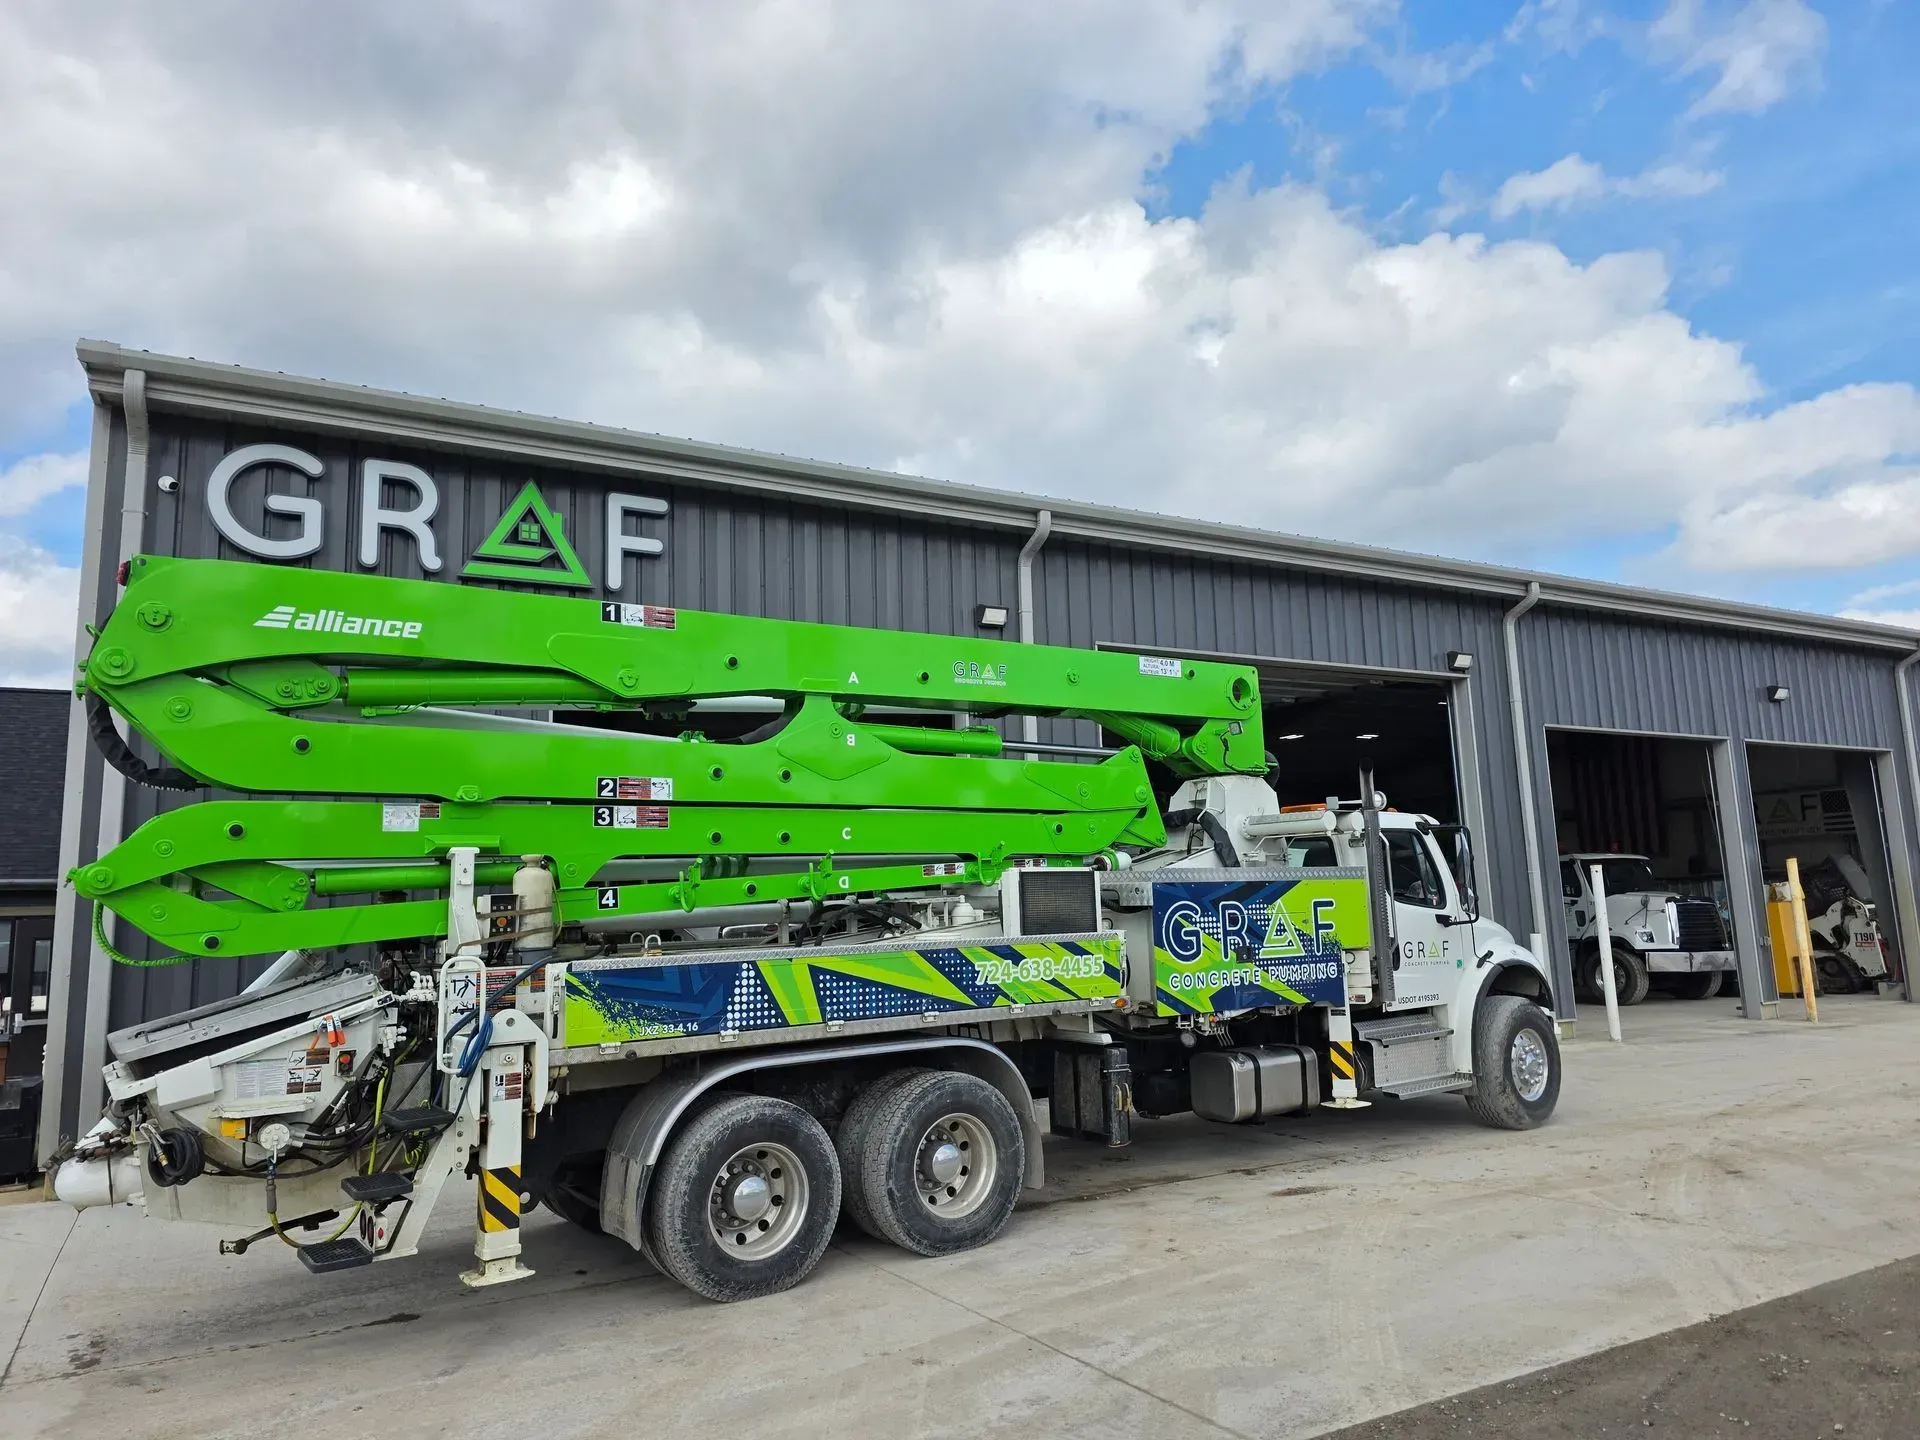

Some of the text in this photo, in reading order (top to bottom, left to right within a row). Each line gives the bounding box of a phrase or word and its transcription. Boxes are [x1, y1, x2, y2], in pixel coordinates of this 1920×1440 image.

[206, 444, 670, 590] GRAF
[605, 604, 616, 621] 1
[294, 608, 423, 639] alliance
[848, 671, 859, 684] A
[953, 661, 1007, 680] GRAF
[600, 778, 614, 797] 2
[597, 807, 611, 826] 3
[841, 827, 852, 840] C
[601, 889, 615, 906] 4
[1162, 898, 1336, 964] GRAF
[1853, 932, 1875, 942] T190
[1403, 940, 1450, 959] GRAF
[976, 954, 1104, 985] 724-638-4455
[1169, 961, 1339, 990] CONCRETE PUMPING
[1397, 993, 1440, 1005] USDOT 4195393
[640, 1025, 659, 1036] JXZ
